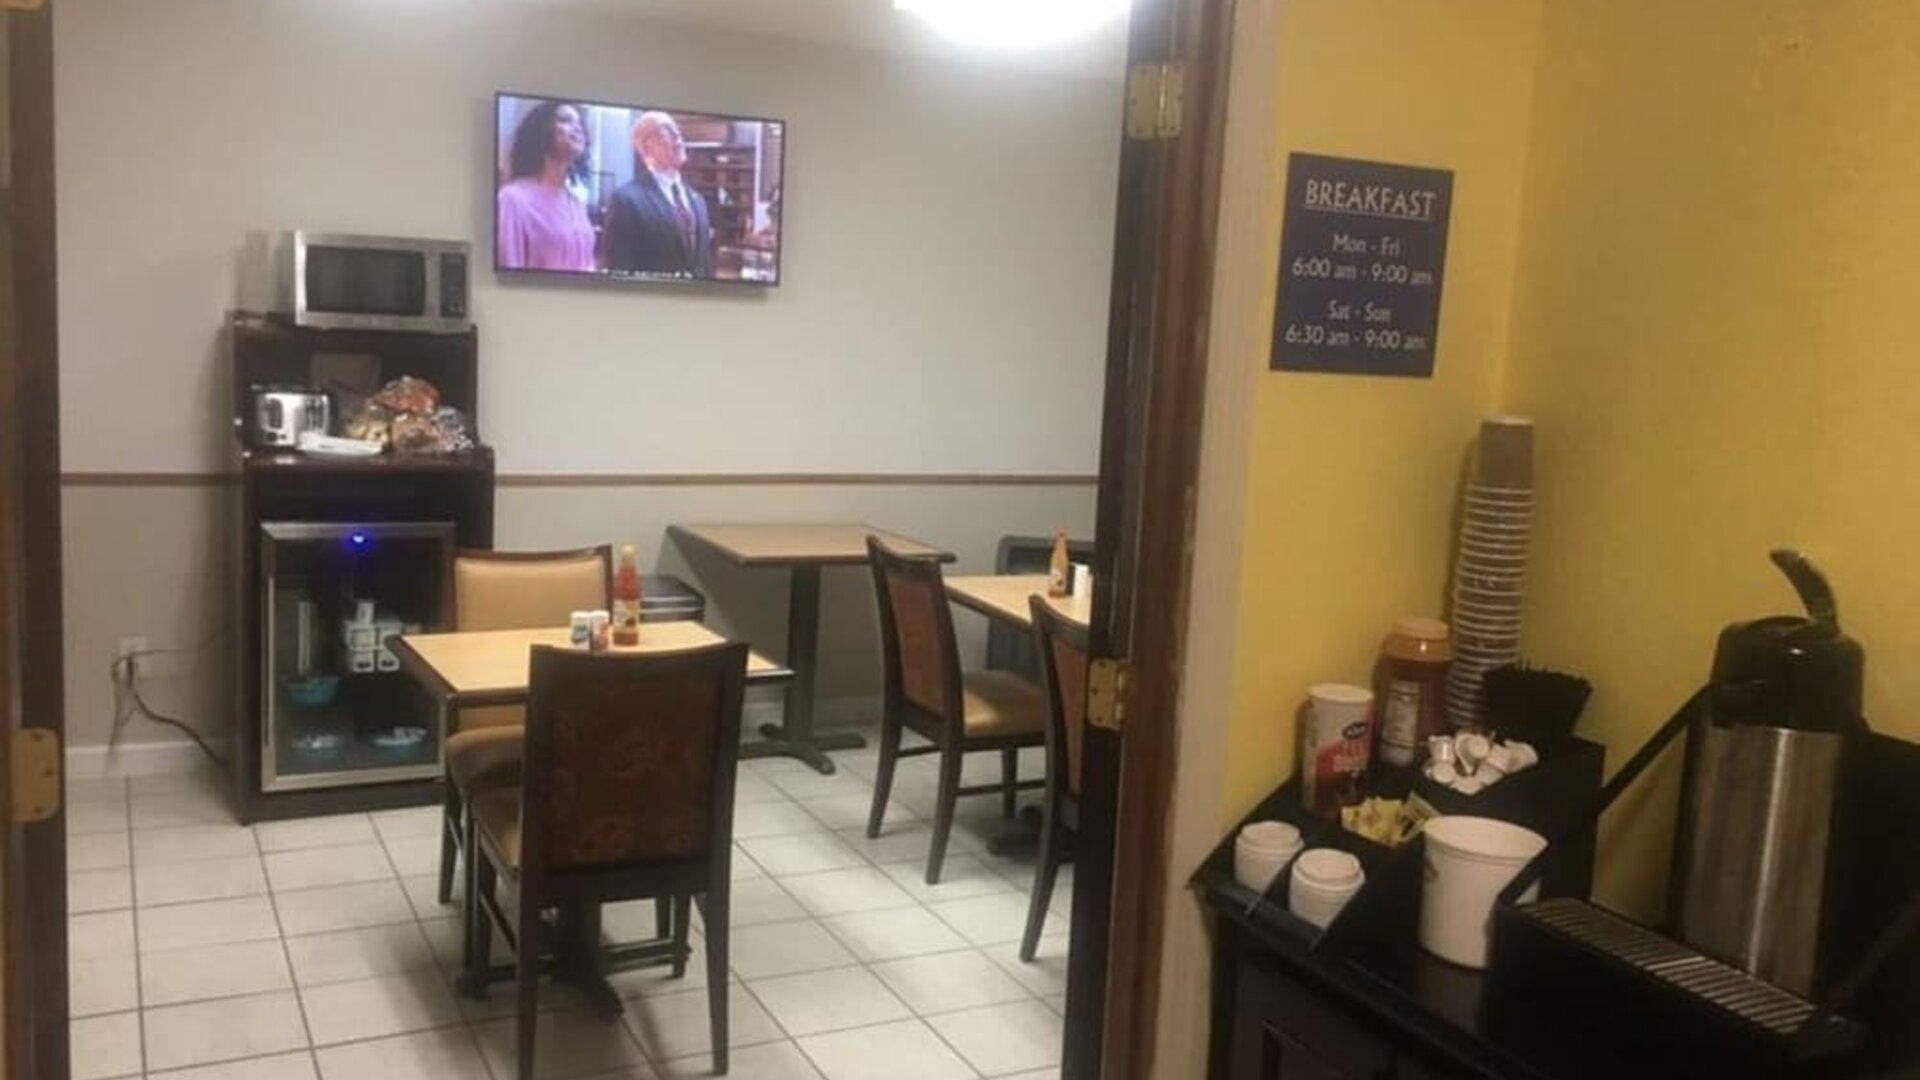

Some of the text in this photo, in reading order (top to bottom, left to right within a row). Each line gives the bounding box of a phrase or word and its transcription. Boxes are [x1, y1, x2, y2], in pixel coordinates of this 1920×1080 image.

[1305, 179, 1437, 217] BREAKFAST
[1333, 233, 1367, 252] Mon
[1381, 235, 1400, 256] Fri
[1292, 257, 1331, 278] 6:00
[1333, 265, 1357, 280] am
[1371, 262, 1408, 283] 9:00
[1410, 271, 1432, 285] am
[1328, 300, 1350, 321] Sat
[1365, 302, 1392, 322] Sun
[1285, 324, 1324, 344] 6:30
[1326, 332, 1350, 346] am
[1365, 329, 1401, 349] 9:00
[1403, 336, 1426, 349] am
